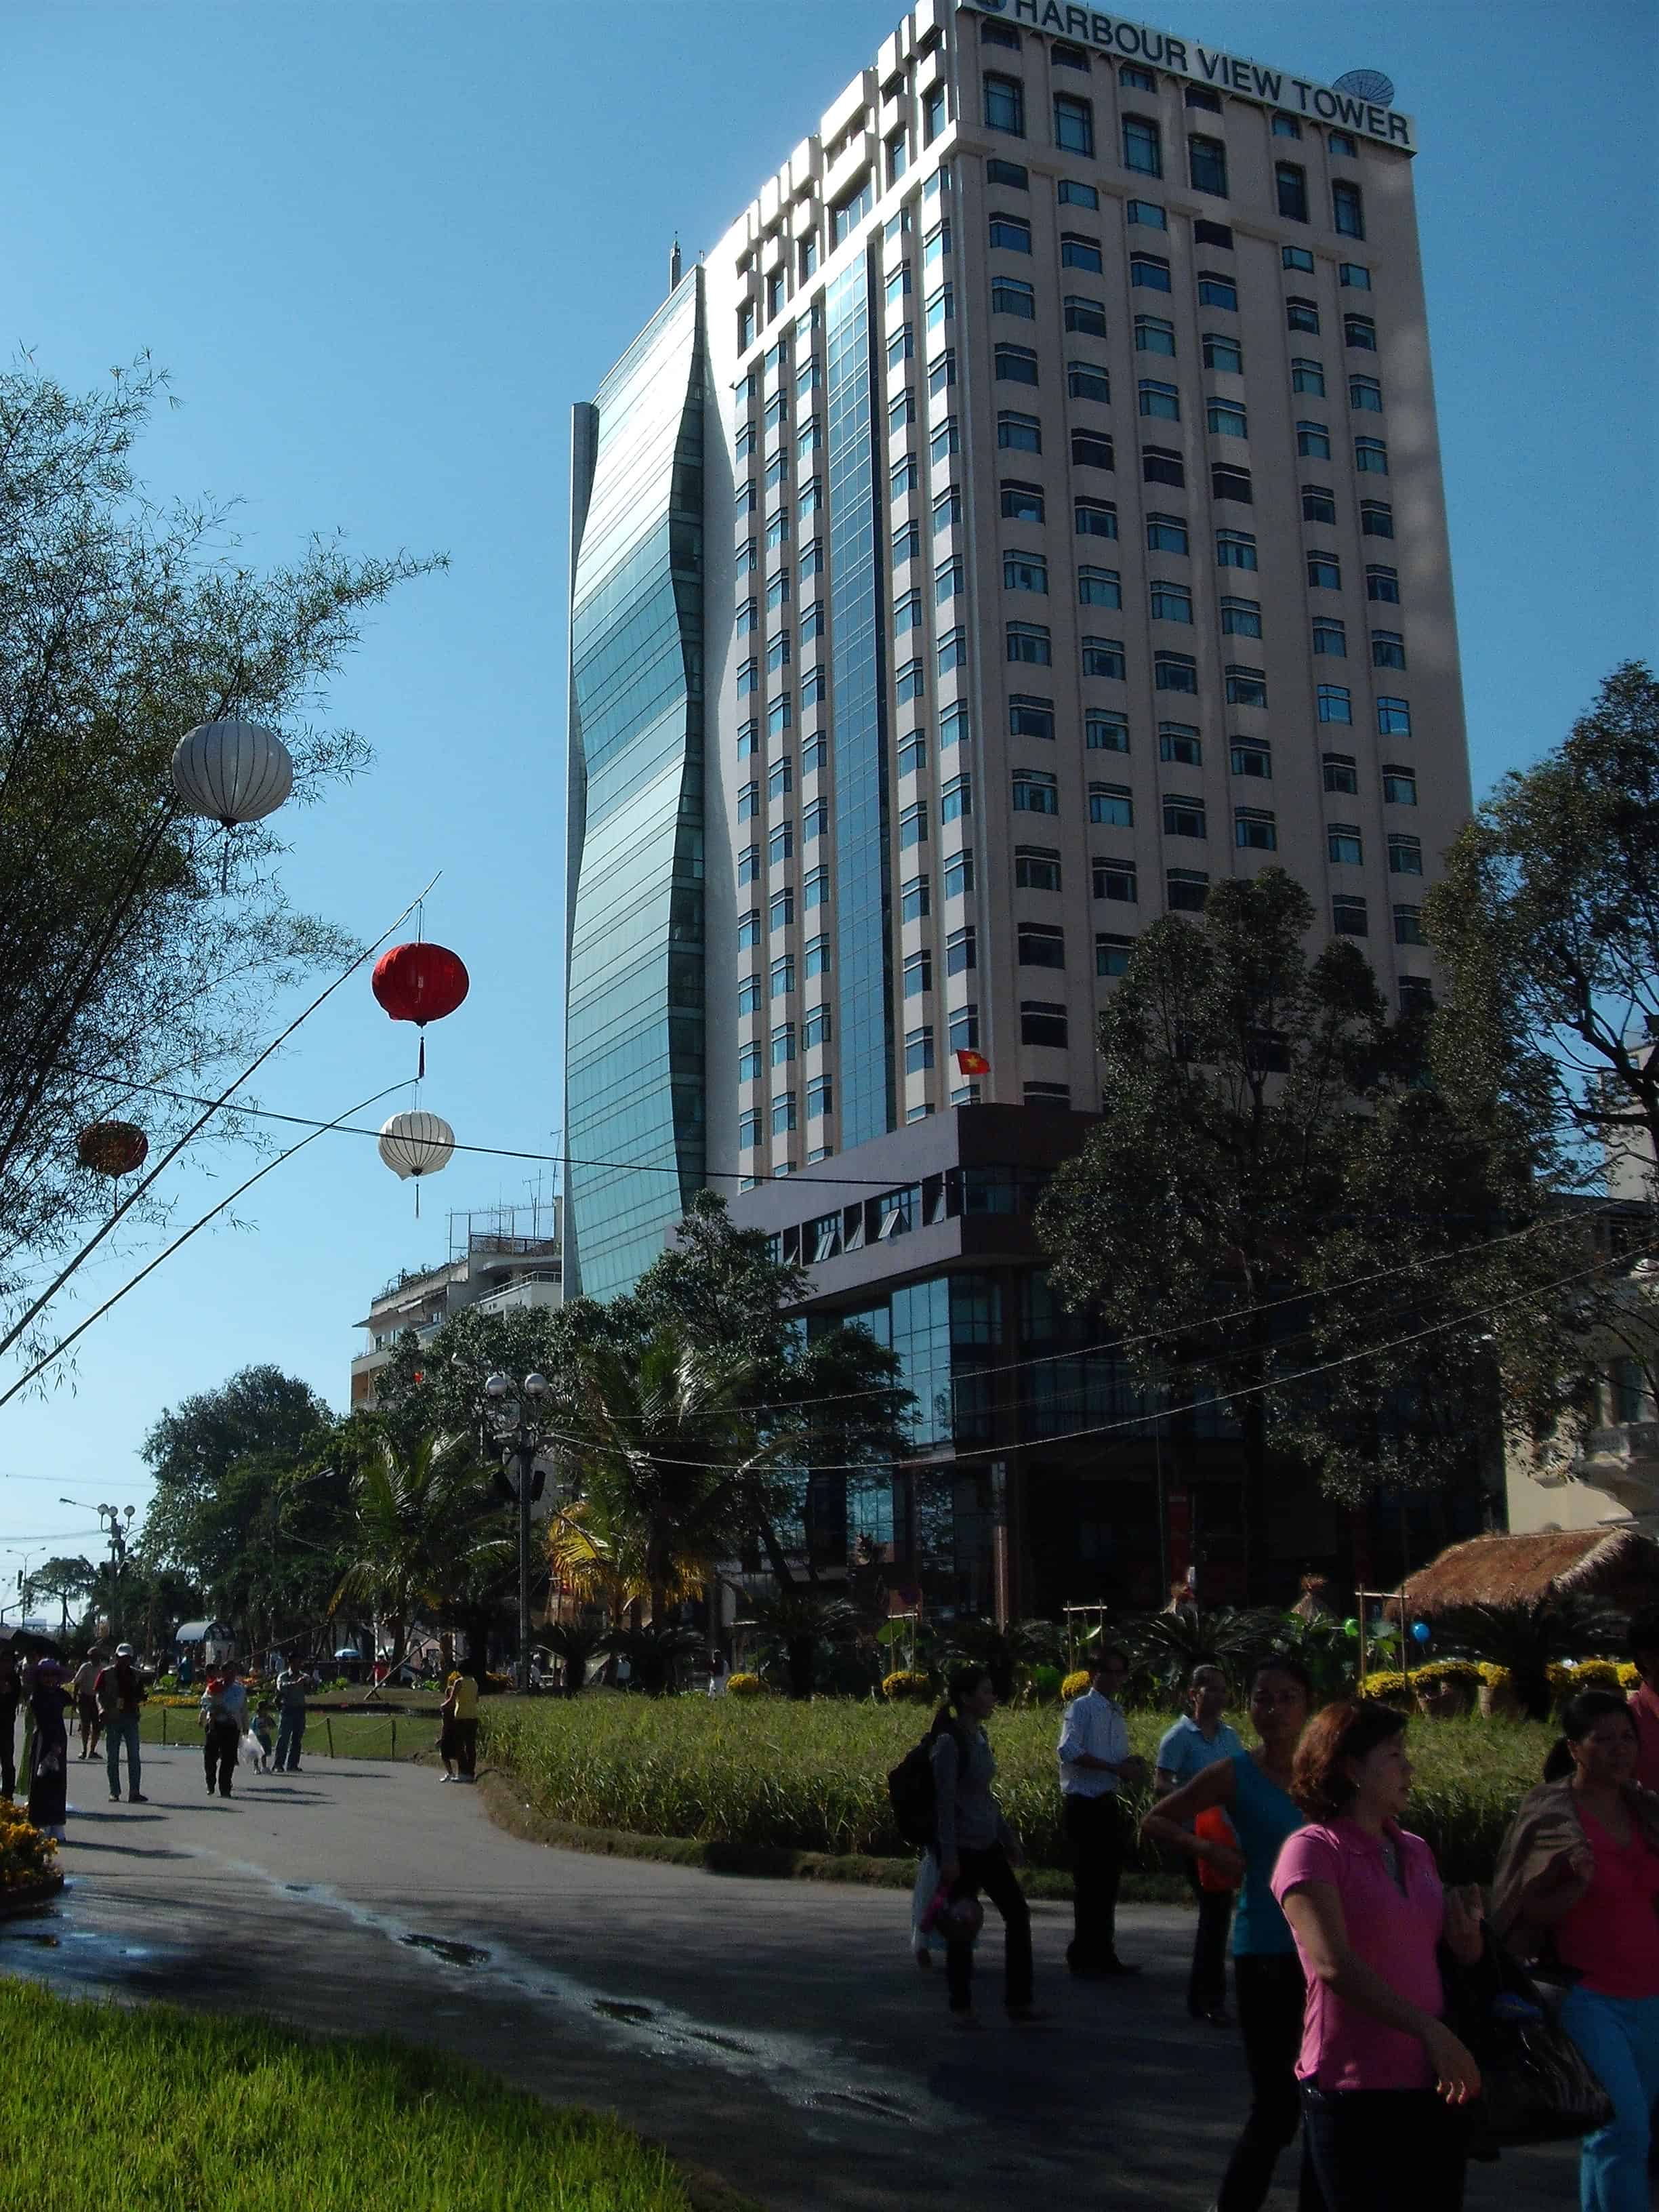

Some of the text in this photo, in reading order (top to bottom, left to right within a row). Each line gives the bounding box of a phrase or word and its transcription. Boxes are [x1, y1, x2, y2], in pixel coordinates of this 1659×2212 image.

[1016, 0, 1410, 144] HARBOUR VIEW TOWER
